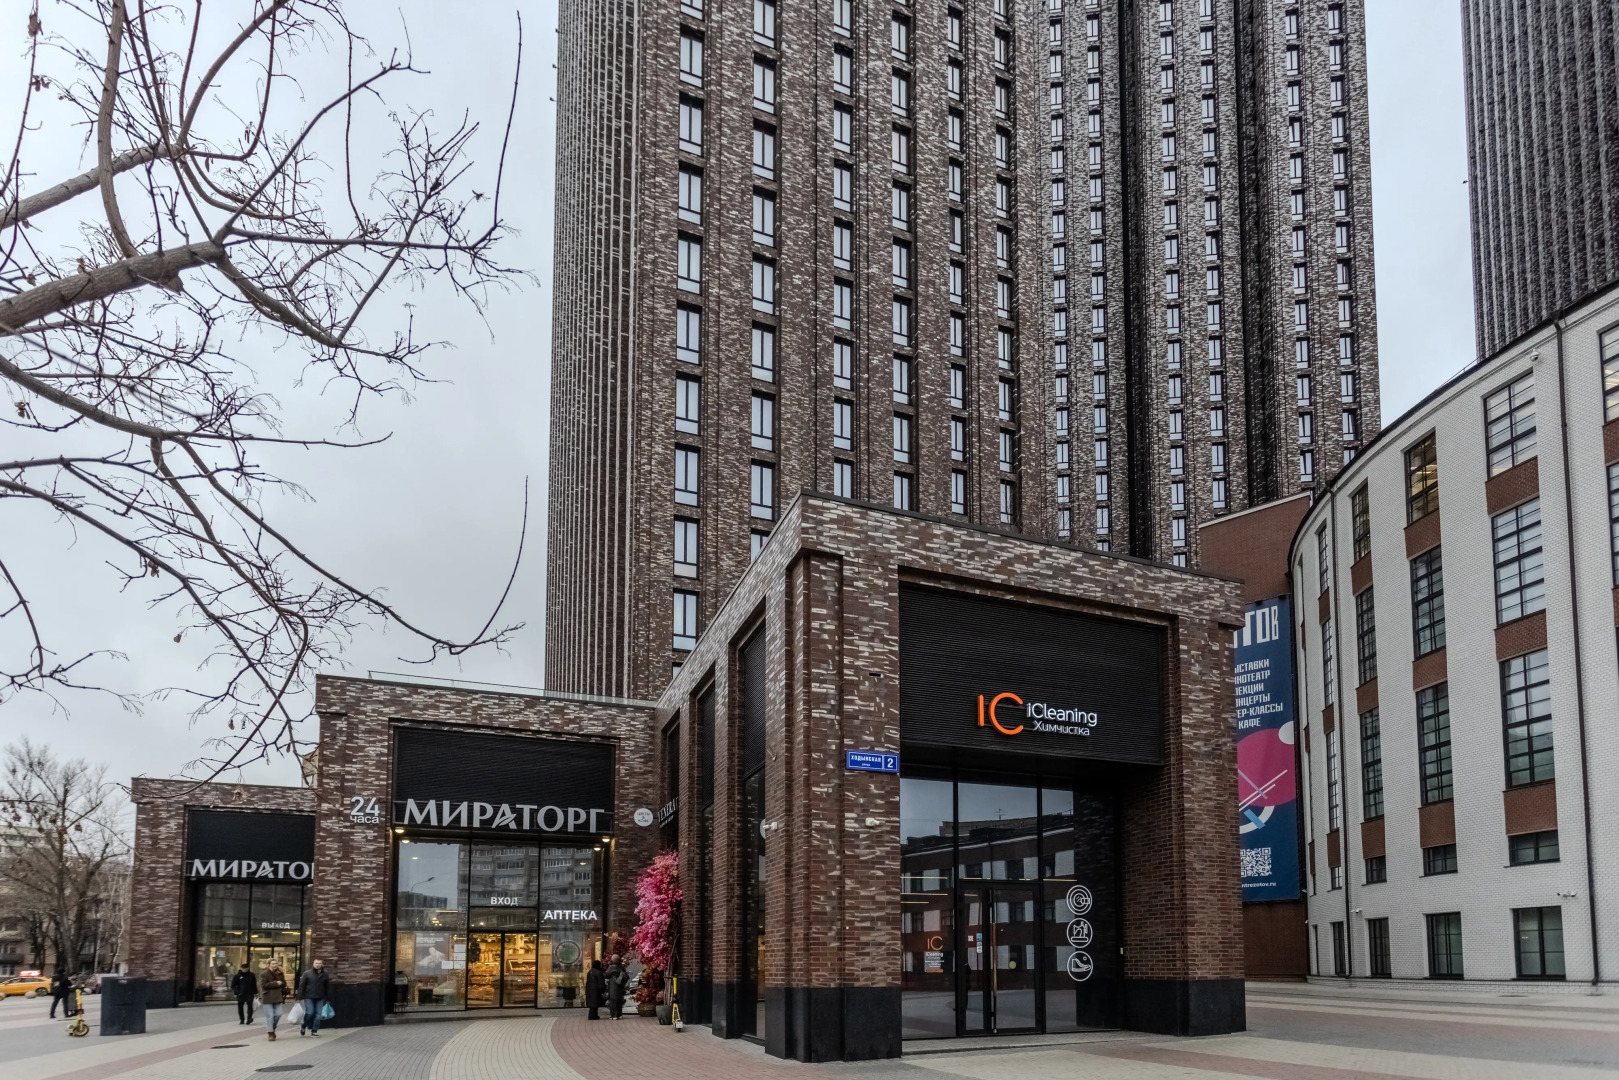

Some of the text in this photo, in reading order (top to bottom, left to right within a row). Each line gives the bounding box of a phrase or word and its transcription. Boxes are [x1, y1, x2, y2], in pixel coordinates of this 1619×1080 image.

[977, 692, 1024, 735] IC
[1027, 702, 1098, 727] iCleaning
[1236, 703, 1283, 718] ЕР-КЛАССЫ
[1033, 720, 1090, 736] Химчистка
[1239, 718, 1260, 729] КАФЕ
[851, 754, 882, 763] ХОДЫНСКАЯ
[887, 757, 894, 768] 2
[350, 796, 380, 816] 24
[350, 814, 380, 824] часа
[403, 798, 605, 833] МИРАТОРГ
[191, 858, 314, 880] МИРАТО
[490, 896, 519, 906] ВХОД
[543, 910, 598, 921] АПТЕКА
